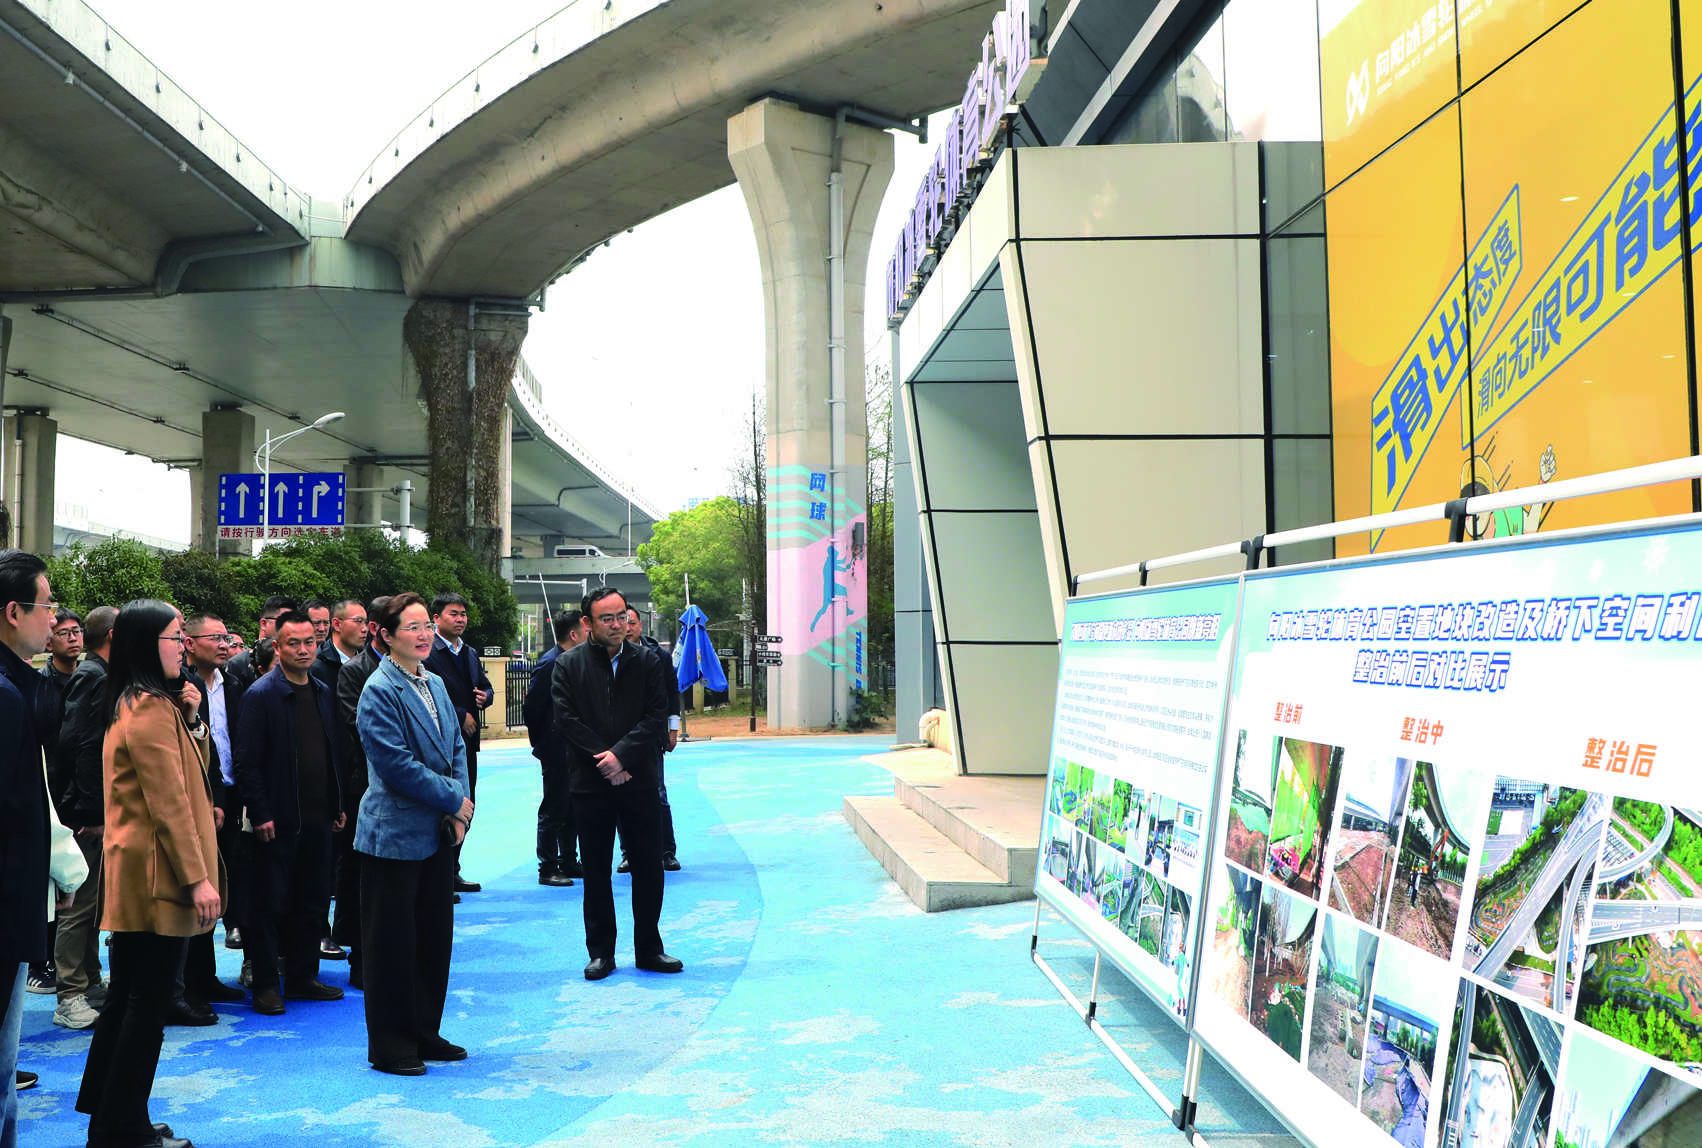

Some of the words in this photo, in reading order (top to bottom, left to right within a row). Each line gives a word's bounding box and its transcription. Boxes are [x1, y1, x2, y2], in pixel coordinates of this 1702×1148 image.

[1373, 218, 1517, 498] 滑出态度
[809, 472, 827, 521] 网球
[1266, 591, 1702, 641] 向阳冰雪轮体育公园空置地块改造及桥下空间利
[1352, 648, 1511, 692] 整治前后对比展示
[1273, 701, 1304, 726] 整治前
[1399, 715, 1445, 746] 整治中
[1581, 736, 1658, 778] 整治后
